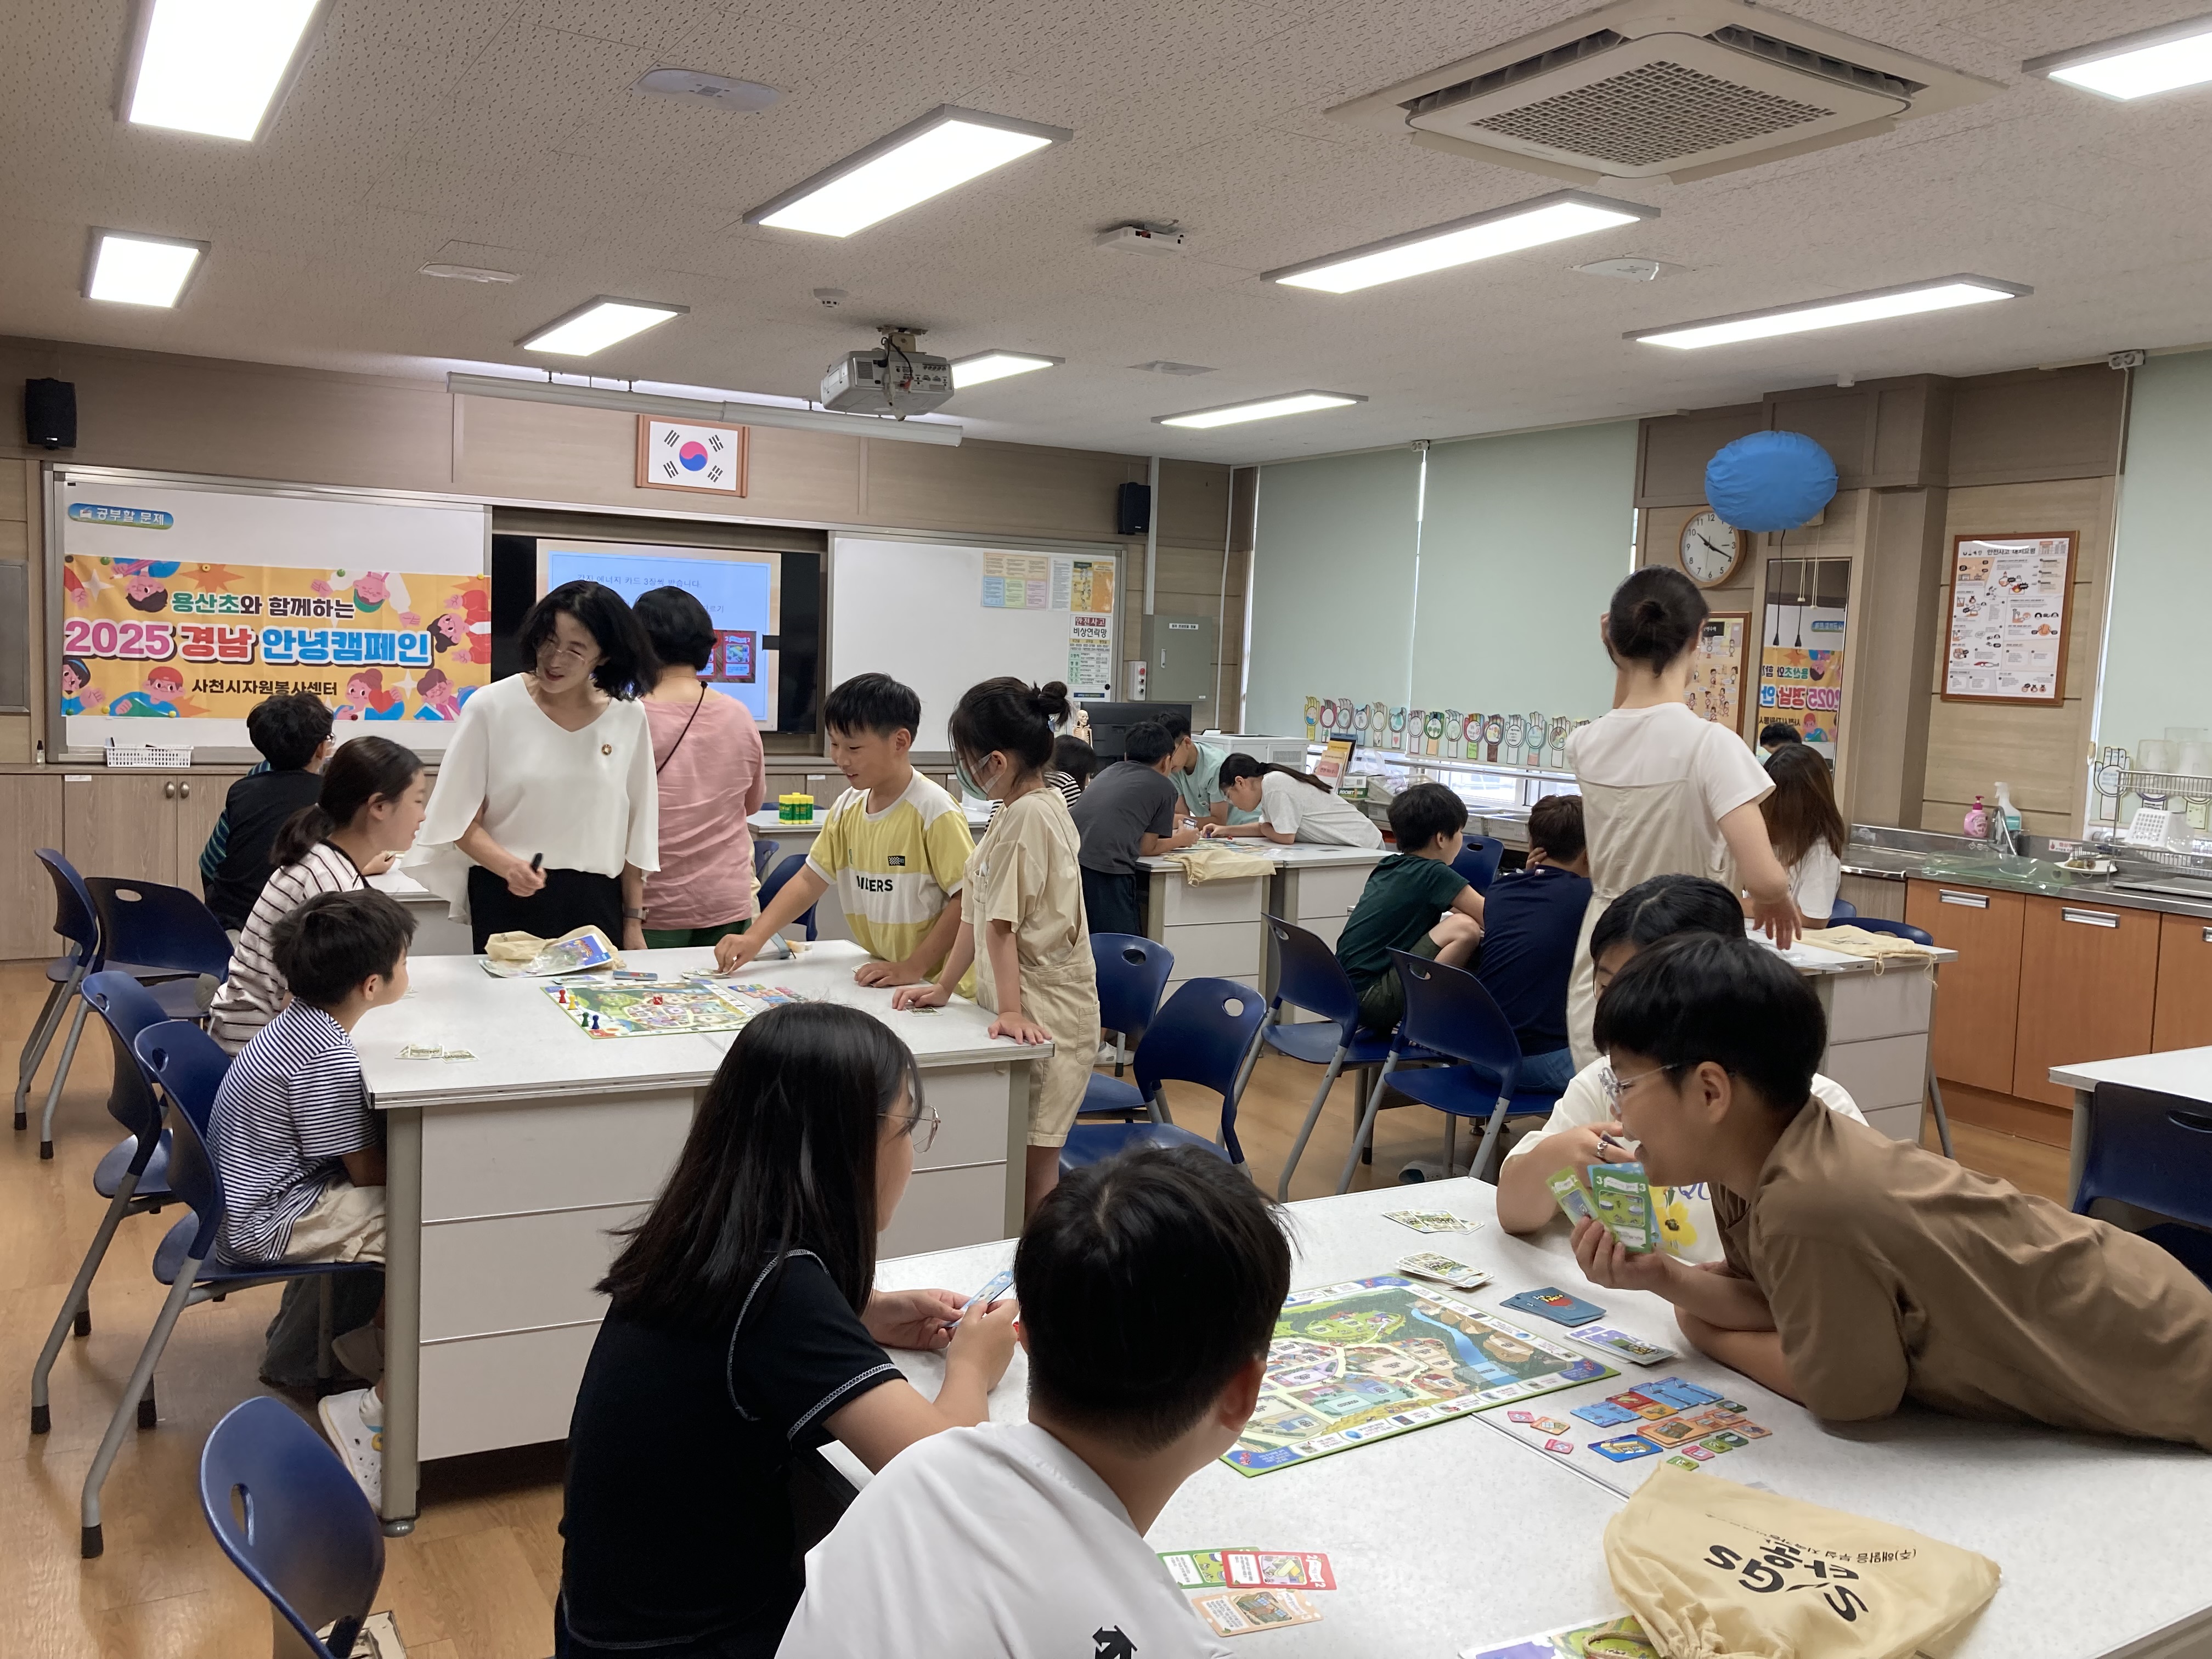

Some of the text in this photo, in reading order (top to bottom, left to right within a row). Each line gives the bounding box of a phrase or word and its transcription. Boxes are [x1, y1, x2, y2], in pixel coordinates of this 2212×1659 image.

[97, 507, 165, 526] 공부할 문제
[1707, 514, 1715, 522] 12
[1686, 543, 1690, 551] 9
[597, 575, 622, 584] 에너지
[625, 577, 641, 585] 카드
[644, 578, 664, 586] 3장씩
[171, 591, 355, 619] 용산초와 함께하는
[1076, 617, 1105, 627] 안전사고
[1074, 627, 1107, 638] 비상연락망
[65, 621, 430, 664] 2025 경남 안녕캠페인
[191, 678, 338, 697] 사천시자원봉사센터
[1759, 1541, 1860, 1580] 타운
[1856, 1548, 1916, 1564] (주)해맑음
